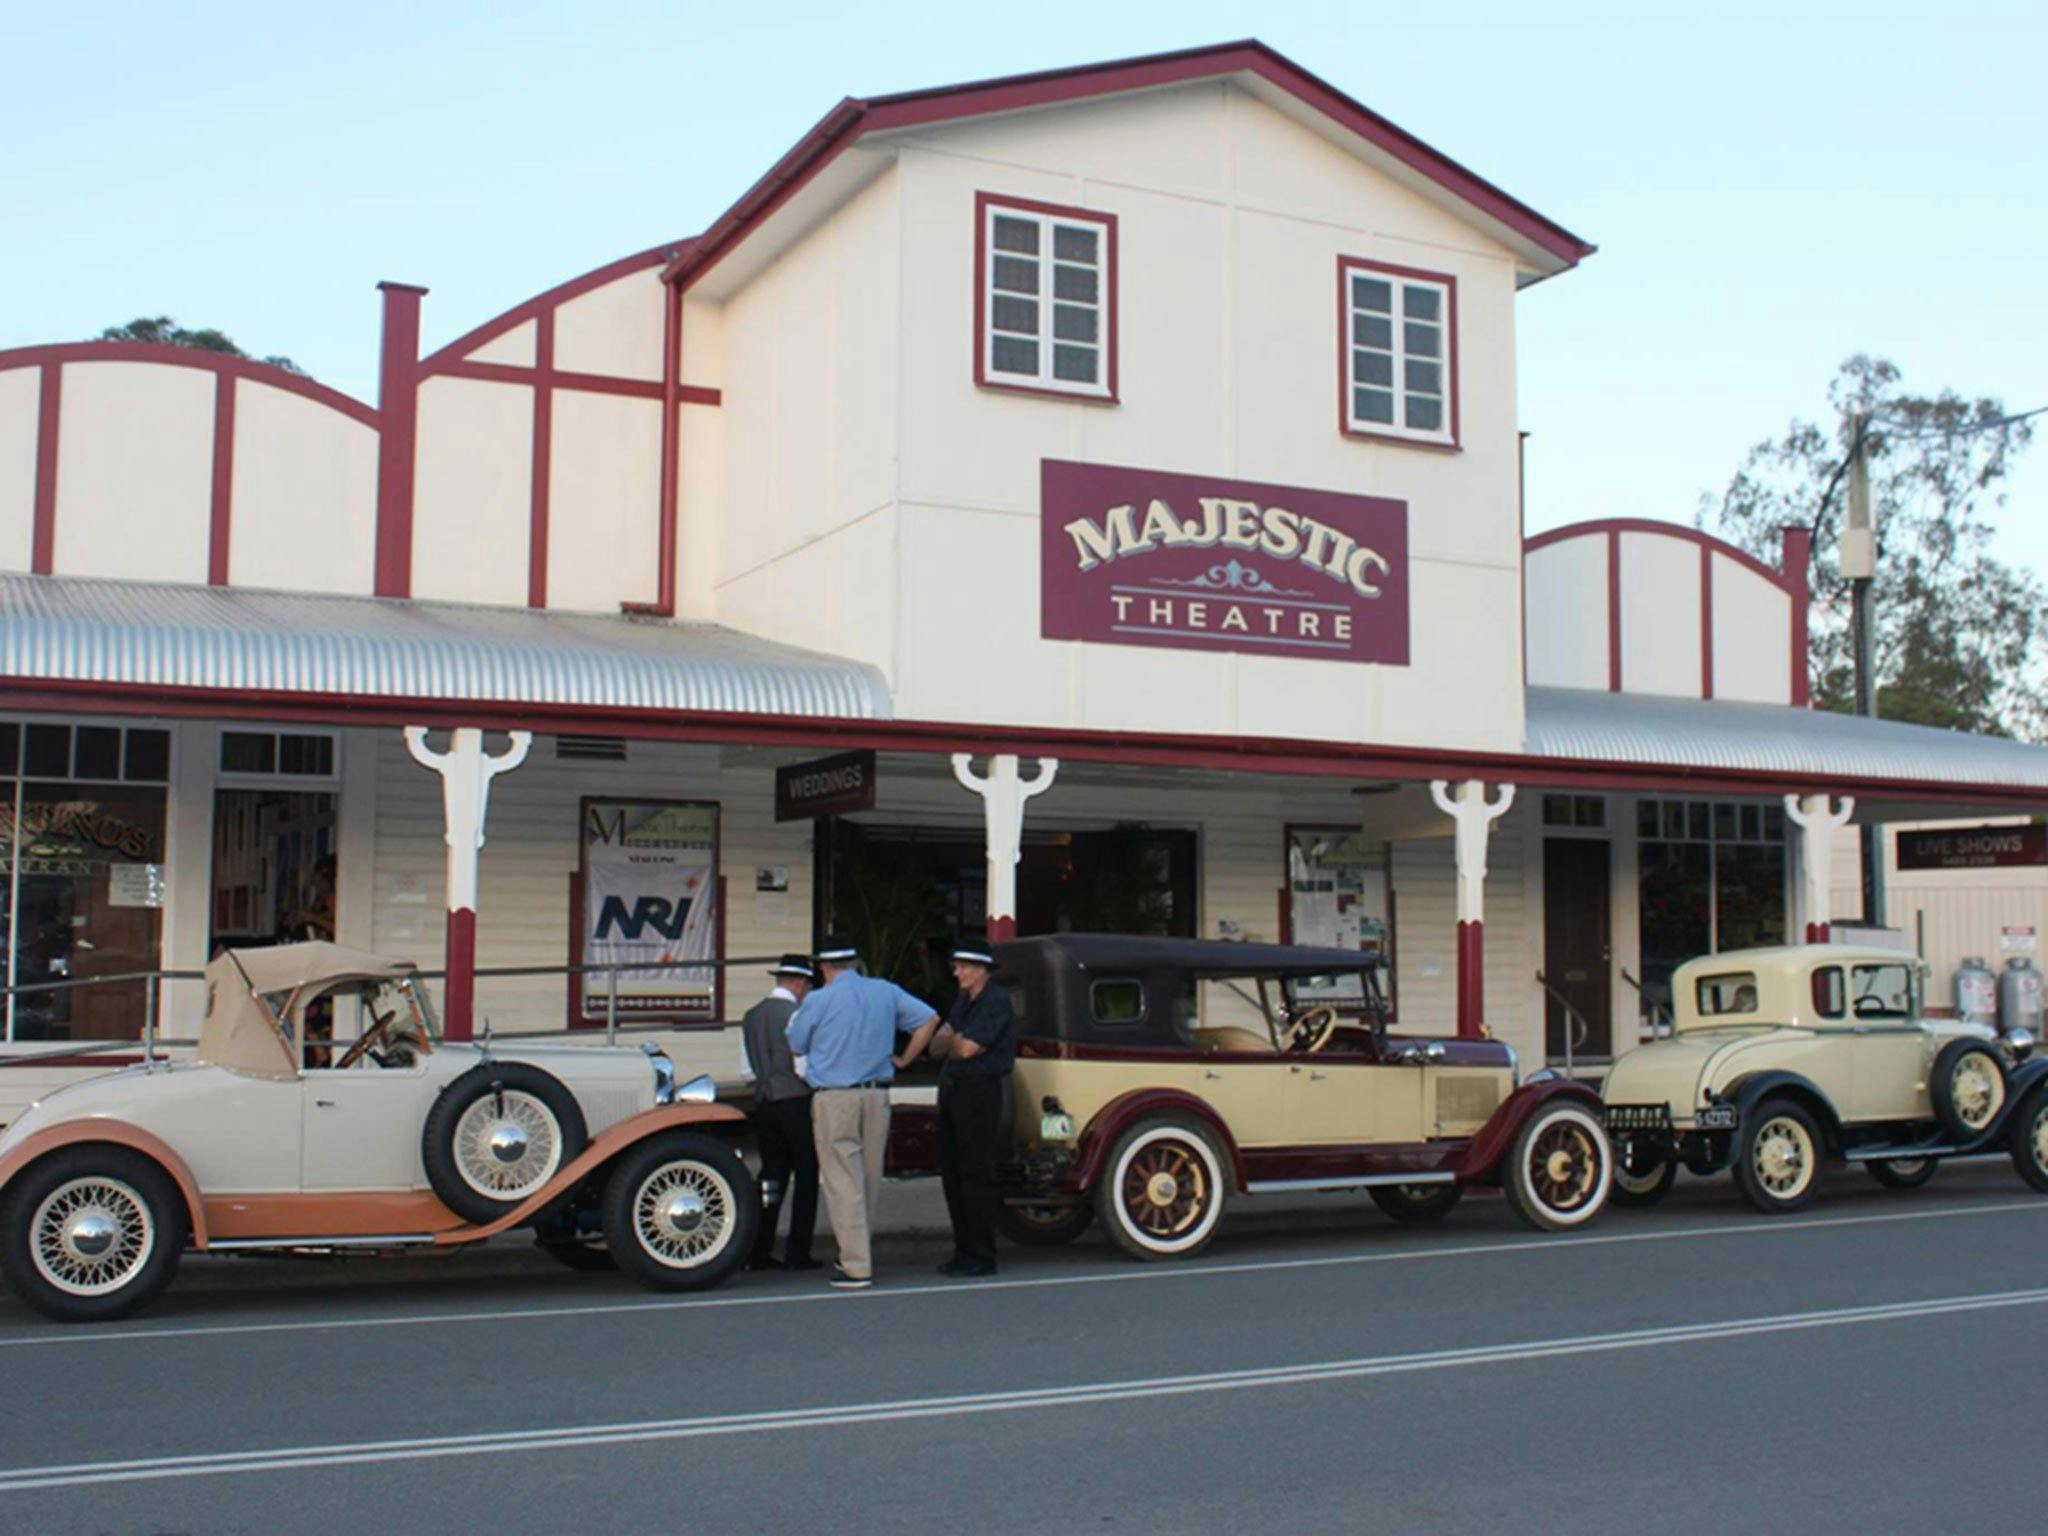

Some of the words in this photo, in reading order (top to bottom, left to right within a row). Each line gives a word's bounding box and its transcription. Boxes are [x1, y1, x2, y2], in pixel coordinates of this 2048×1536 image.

[1064, 498, 1390, 598] MAJESTIC
[1111, 596, 1352, 639] THEATRE
[789, 764, 862, 798] WEDDINGS
[1916, 838, 1951, 855] LIVE
[1957, 834, 2022, 853] SHOWS
